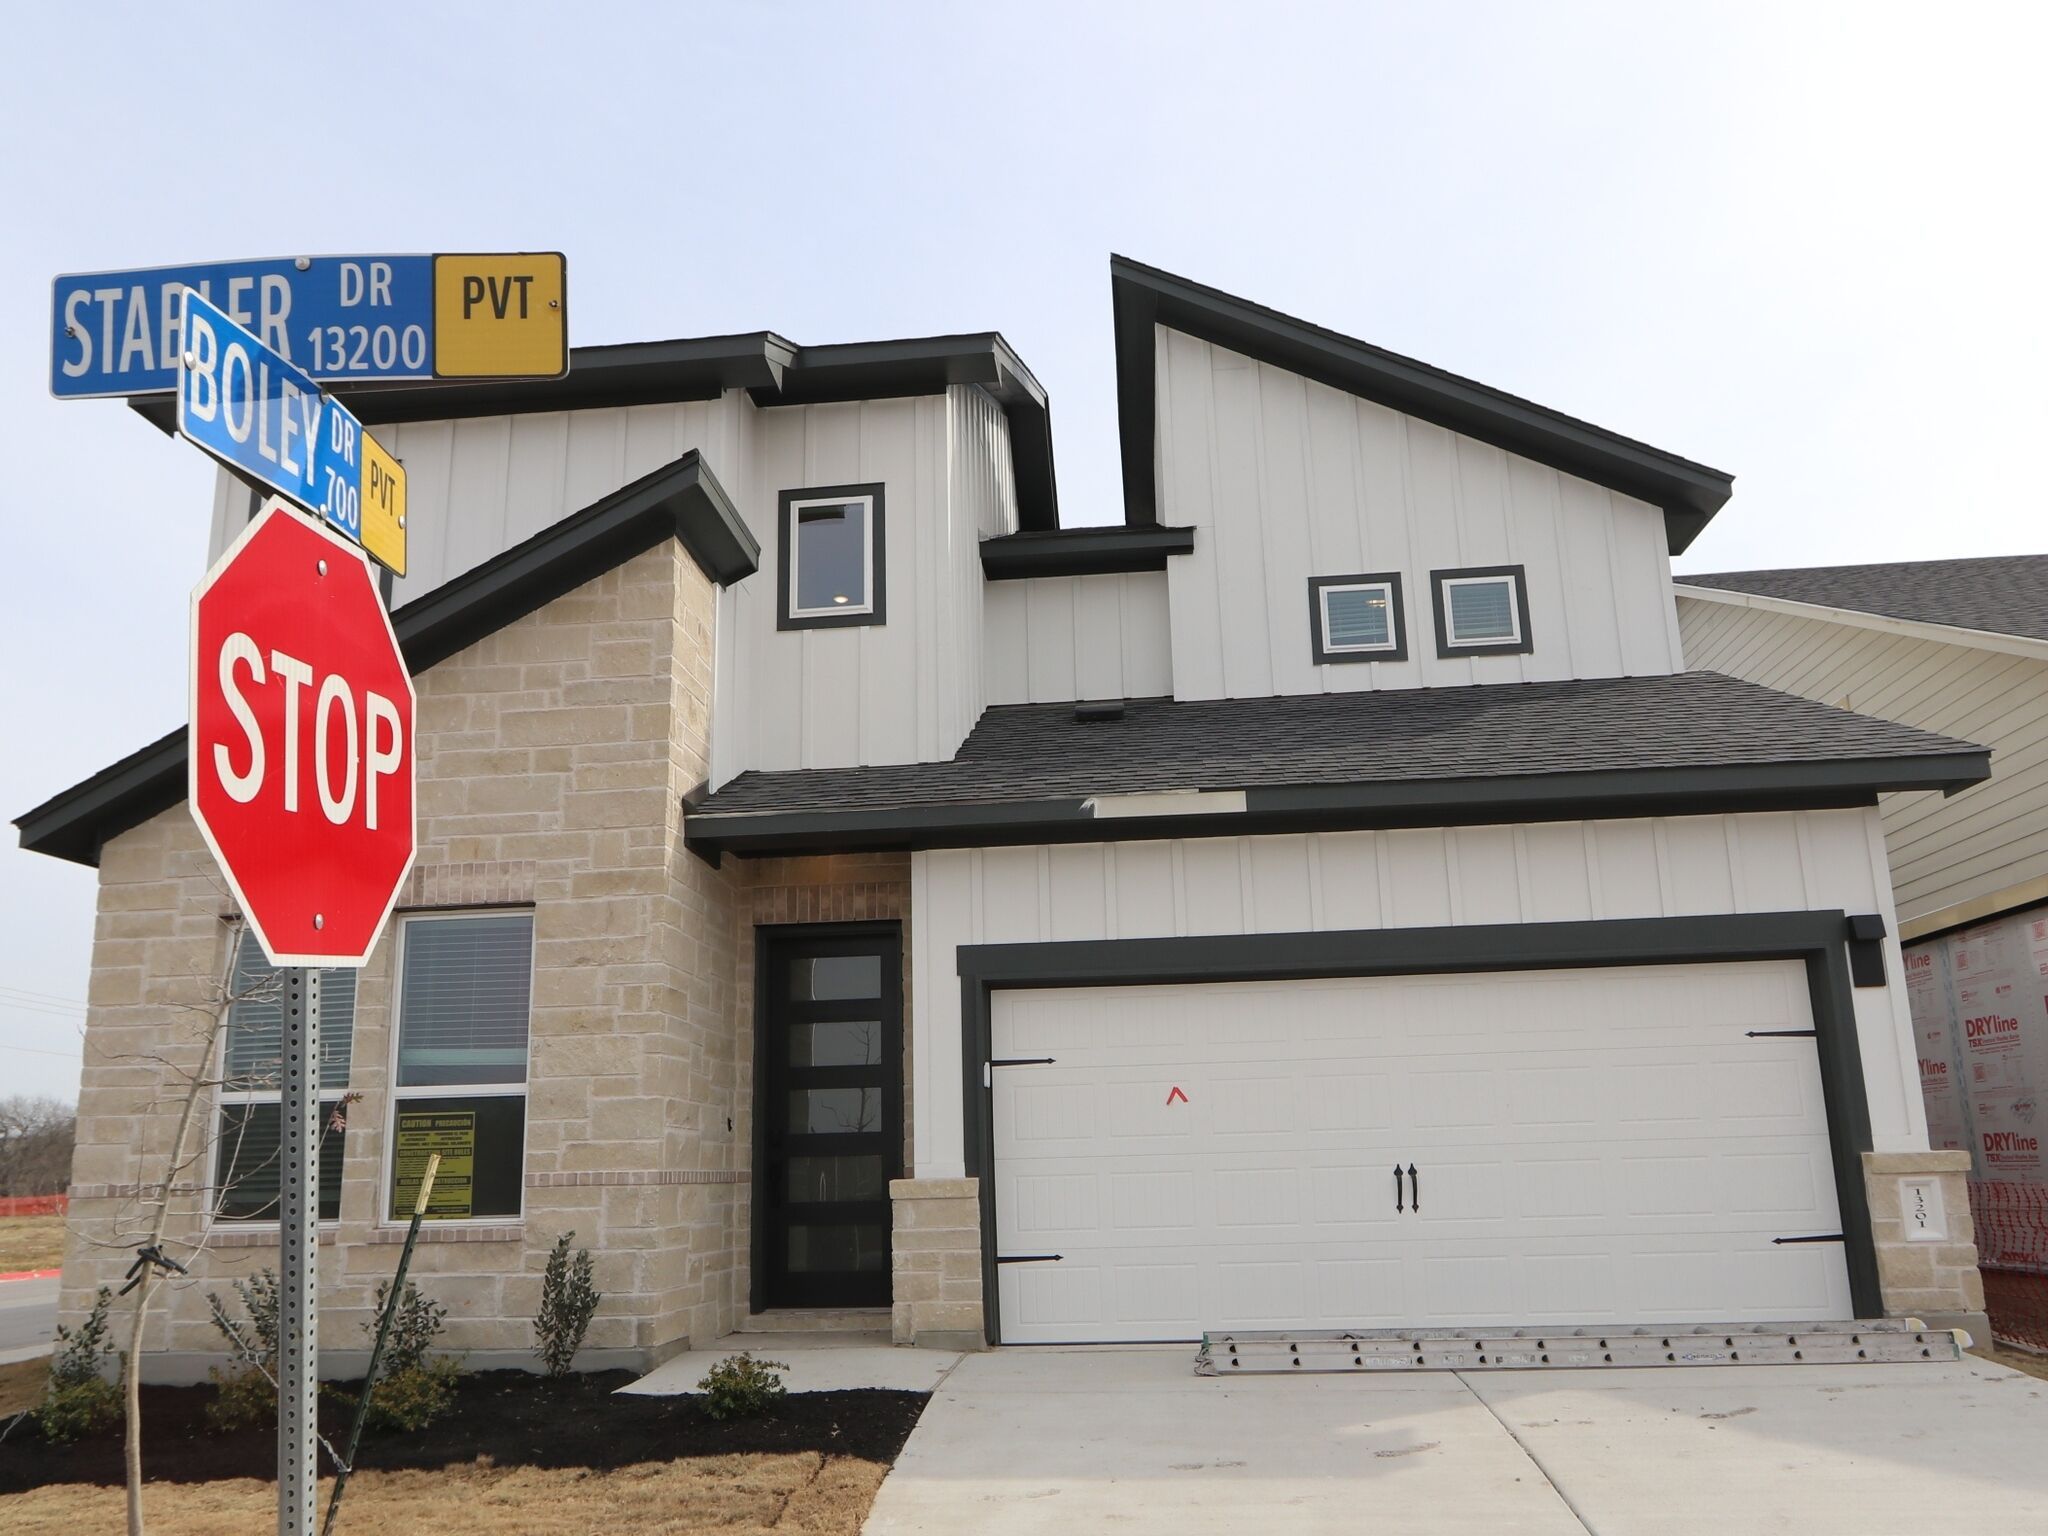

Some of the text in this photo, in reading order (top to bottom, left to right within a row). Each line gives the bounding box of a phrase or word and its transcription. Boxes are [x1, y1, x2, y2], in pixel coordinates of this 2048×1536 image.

[339, 262, 393, 307] DR
[463, 275, 533, 320] PVT
[62, 273, 292, 378] STABER
[307, 324, 427, 372] 13200
[190, 313, 323, 487] BOLEY
[331, 407, 355, 467] DR
[325, 465, 358, 530] 700
[370, 459, 396, 516] PVT
[213, 632, 402, 831] STOP
[1903, 953, 1931, 970] Yline
[1965, 1014, 2018, 1038] DRYline
[1918, 1058, 1947, 1076] Yline
[1983, 1132, 2038, 1151] DRYline
